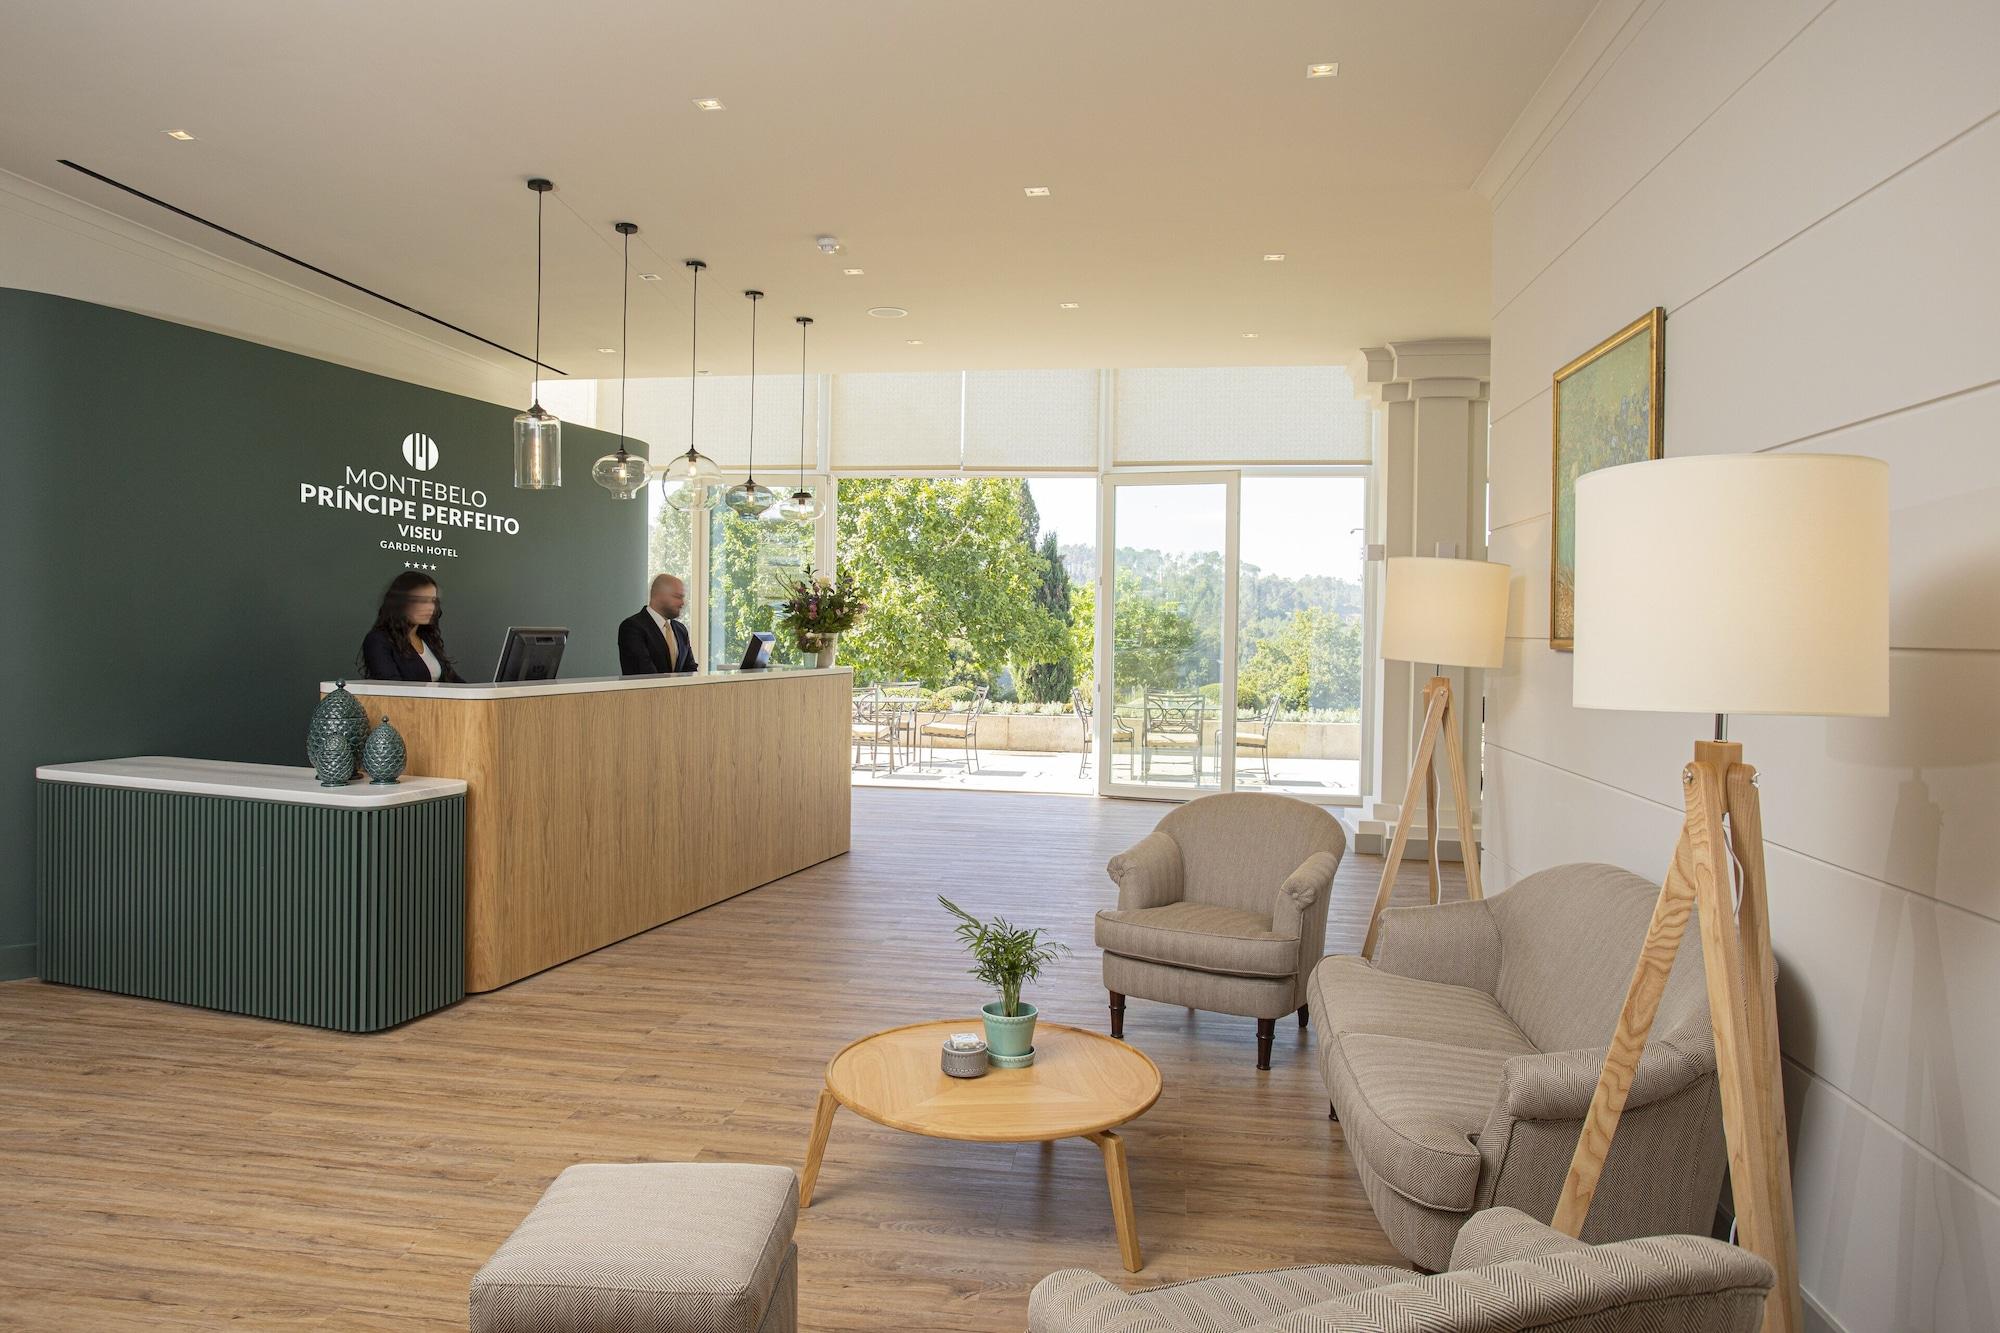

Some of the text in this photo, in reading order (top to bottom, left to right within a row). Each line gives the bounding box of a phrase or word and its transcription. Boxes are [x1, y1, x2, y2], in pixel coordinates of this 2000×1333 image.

[346, 466, 487, 508] MONTEBELO
[300, 483, 520, 535] PRÍNCIPE PERFEITO
[398, 524, 442, 542] VISEU
[380, 540, 458, 558] GARDEN HOTEL
